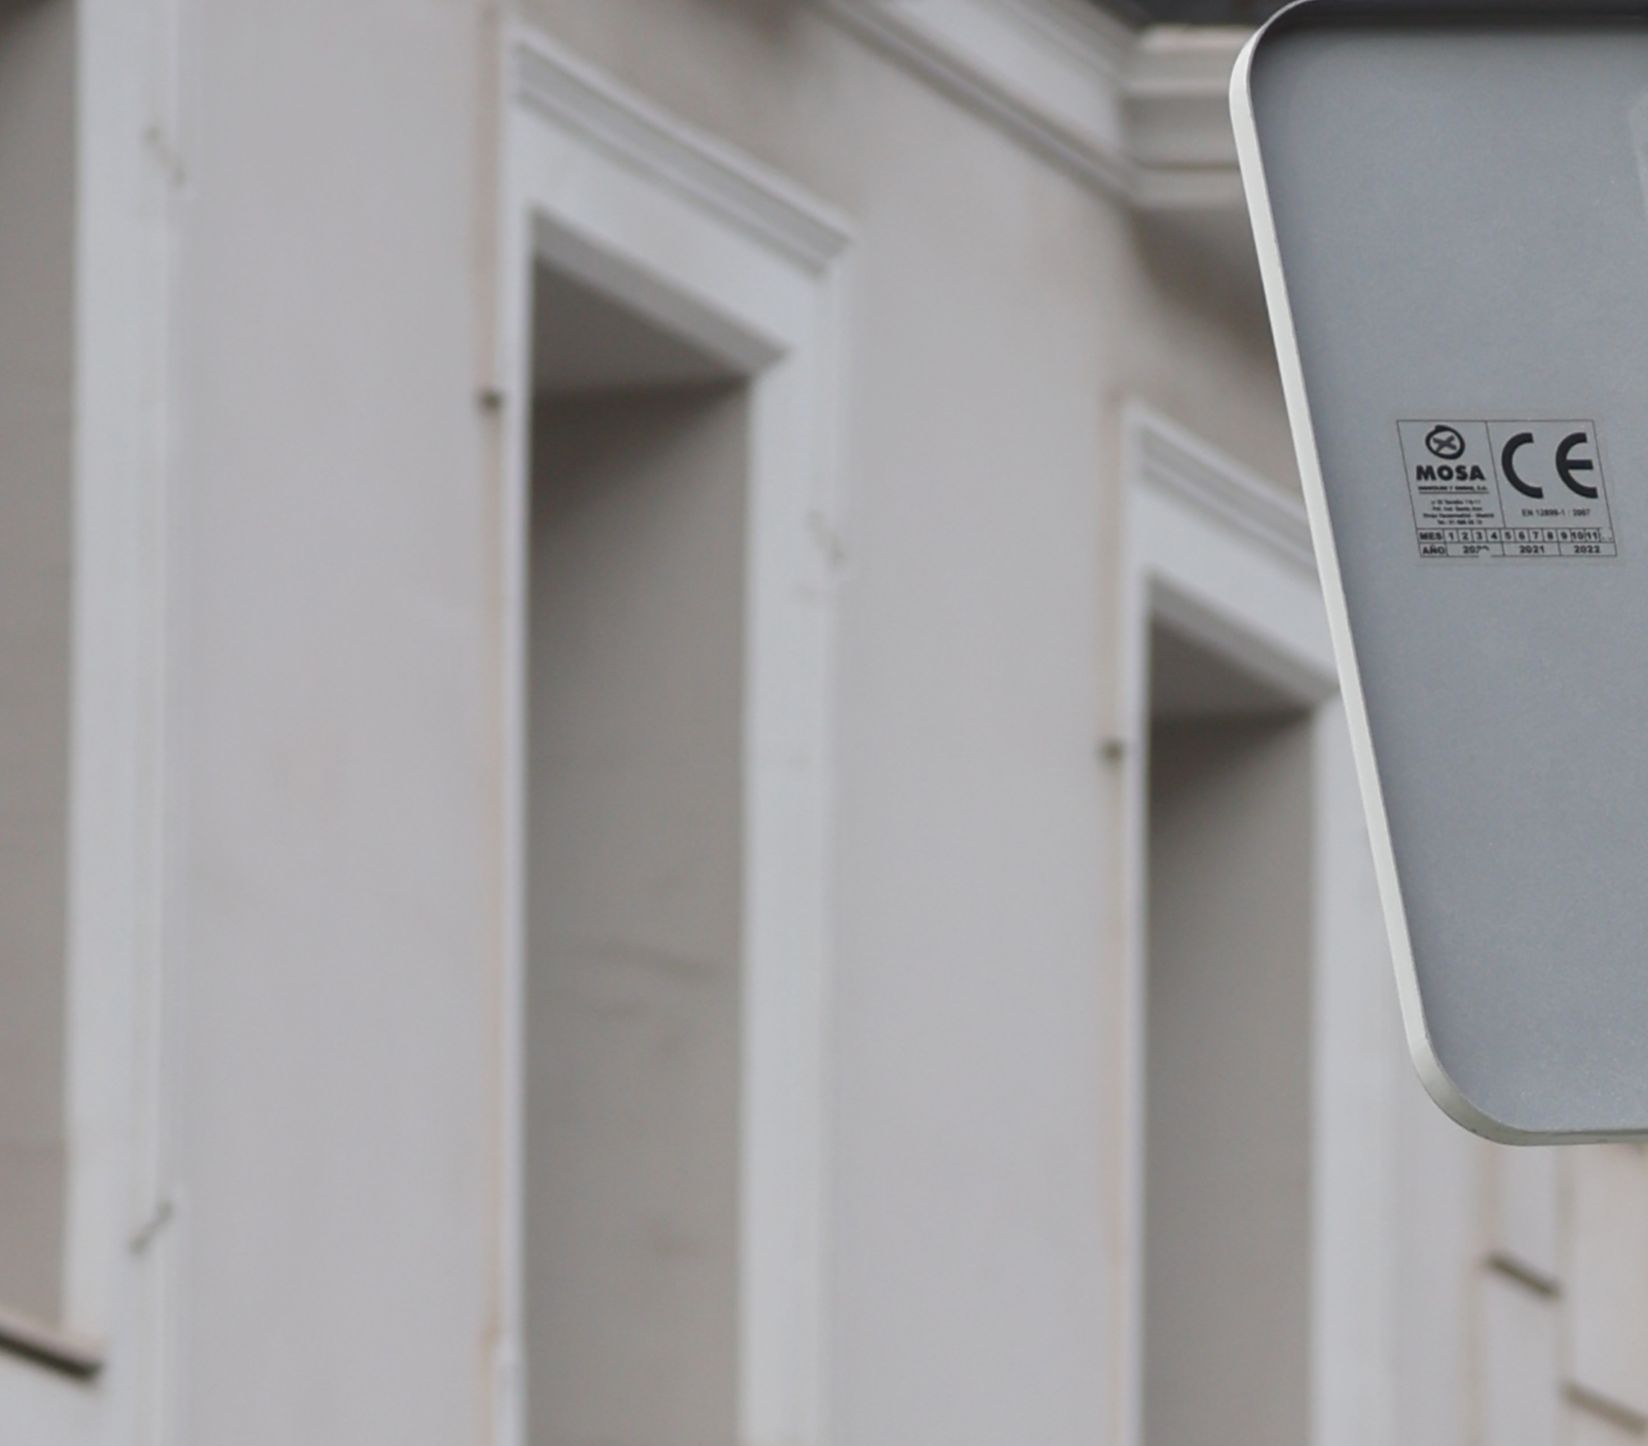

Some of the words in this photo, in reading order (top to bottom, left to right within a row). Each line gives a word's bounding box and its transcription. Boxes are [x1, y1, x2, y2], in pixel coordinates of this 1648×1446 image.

[1501, 432, 1598, 498] CE
[1416, 465, 1486, 481] MOSA
[1522, 508, 1534, 516] EN
[1420, 532, 1442, 540] MES
[1520, 545, 1545, 554] 2021
[1574, 545, 1600, 554] 2022
